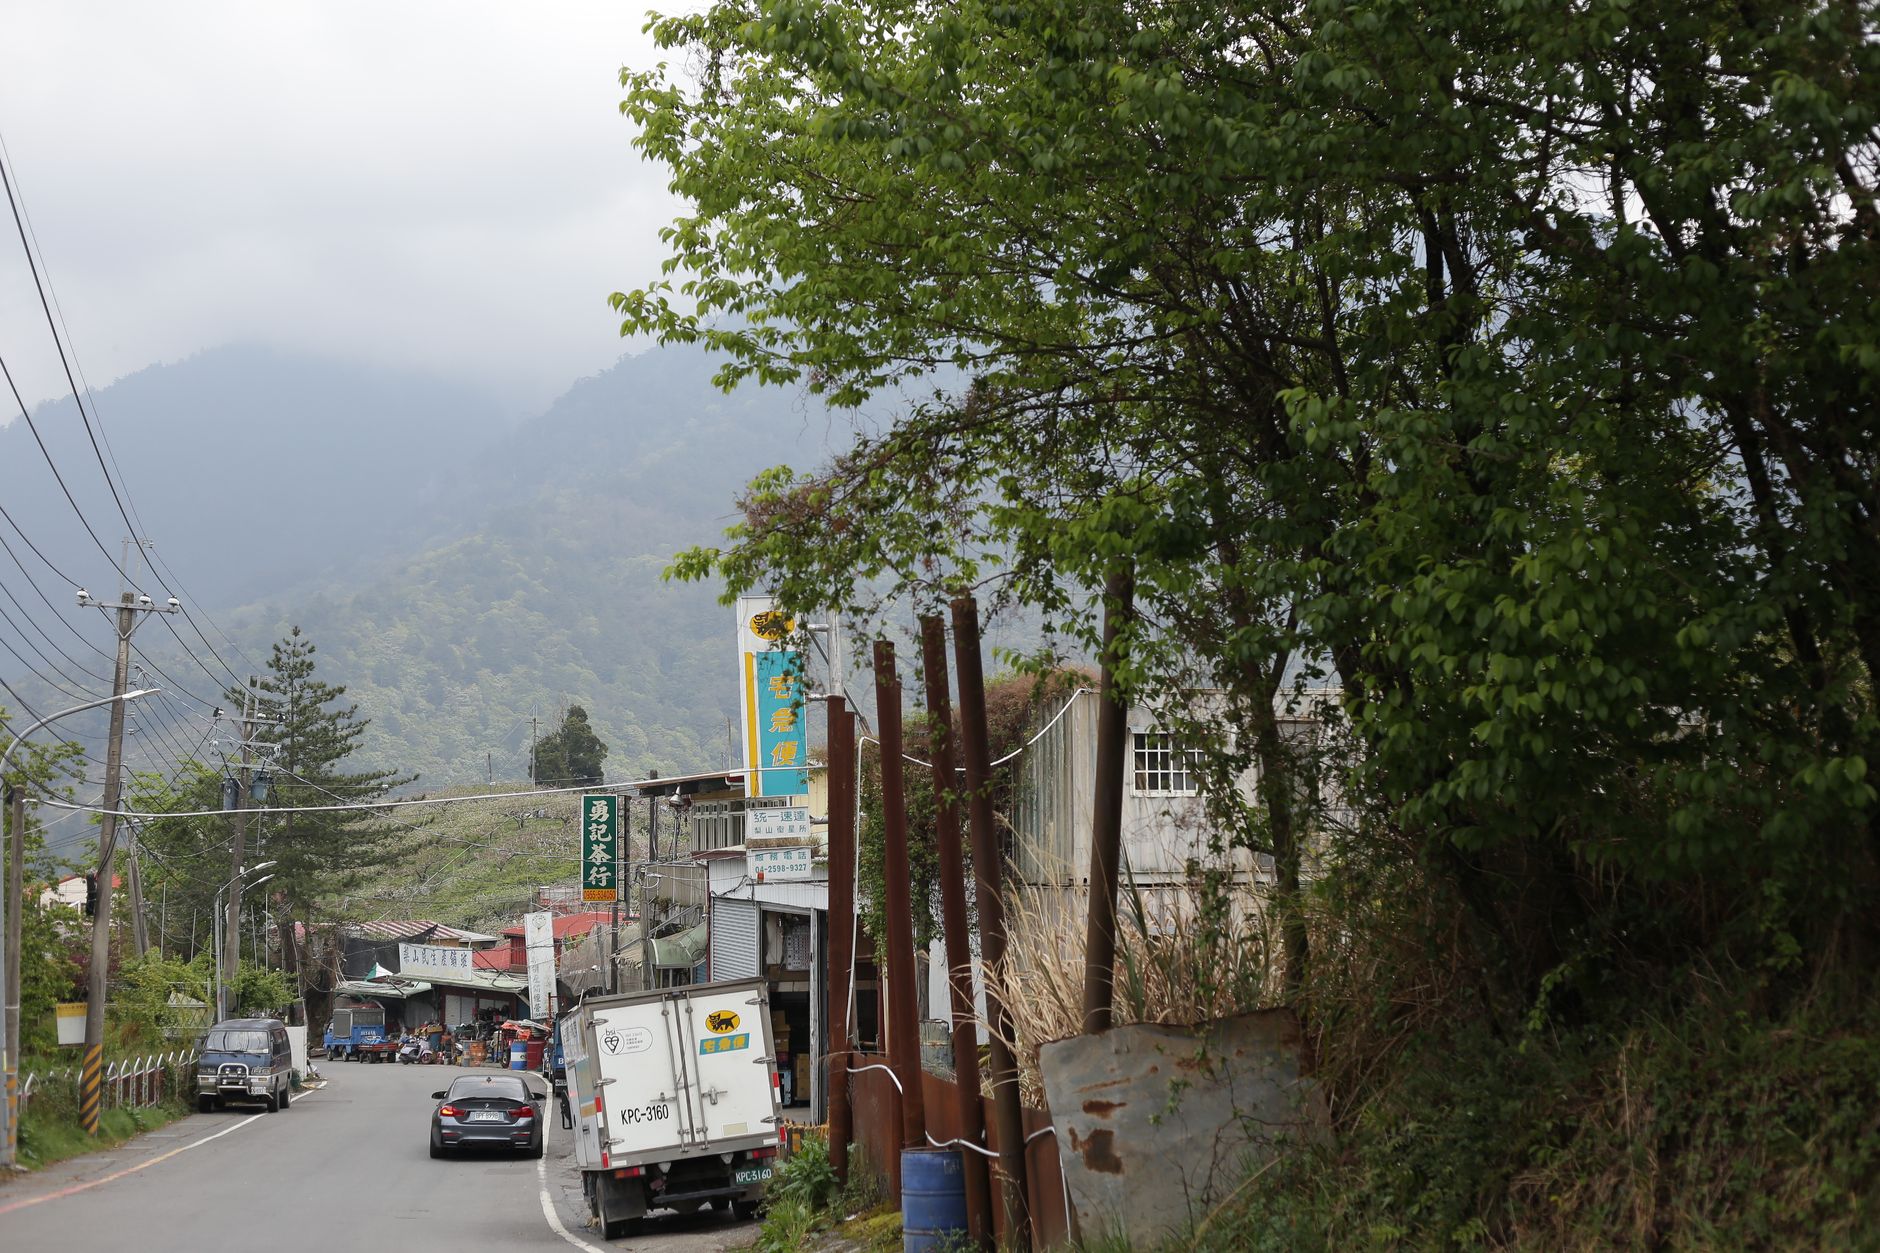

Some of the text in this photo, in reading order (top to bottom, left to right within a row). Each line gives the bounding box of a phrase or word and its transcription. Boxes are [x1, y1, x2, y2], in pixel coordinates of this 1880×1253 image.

[768, 674, 799, 767] 宅急便
[753, 810, 806, 823] 統一速達
[587, 799, 613, 887] 勇記茶行
[754, 850, 807, 862] 服務電話
[754, 863, 807, 873] 04-2598-9327
[605, 1028, 616, 1036] bsi
[620, 1103, 669, 1125] KPC-3160
